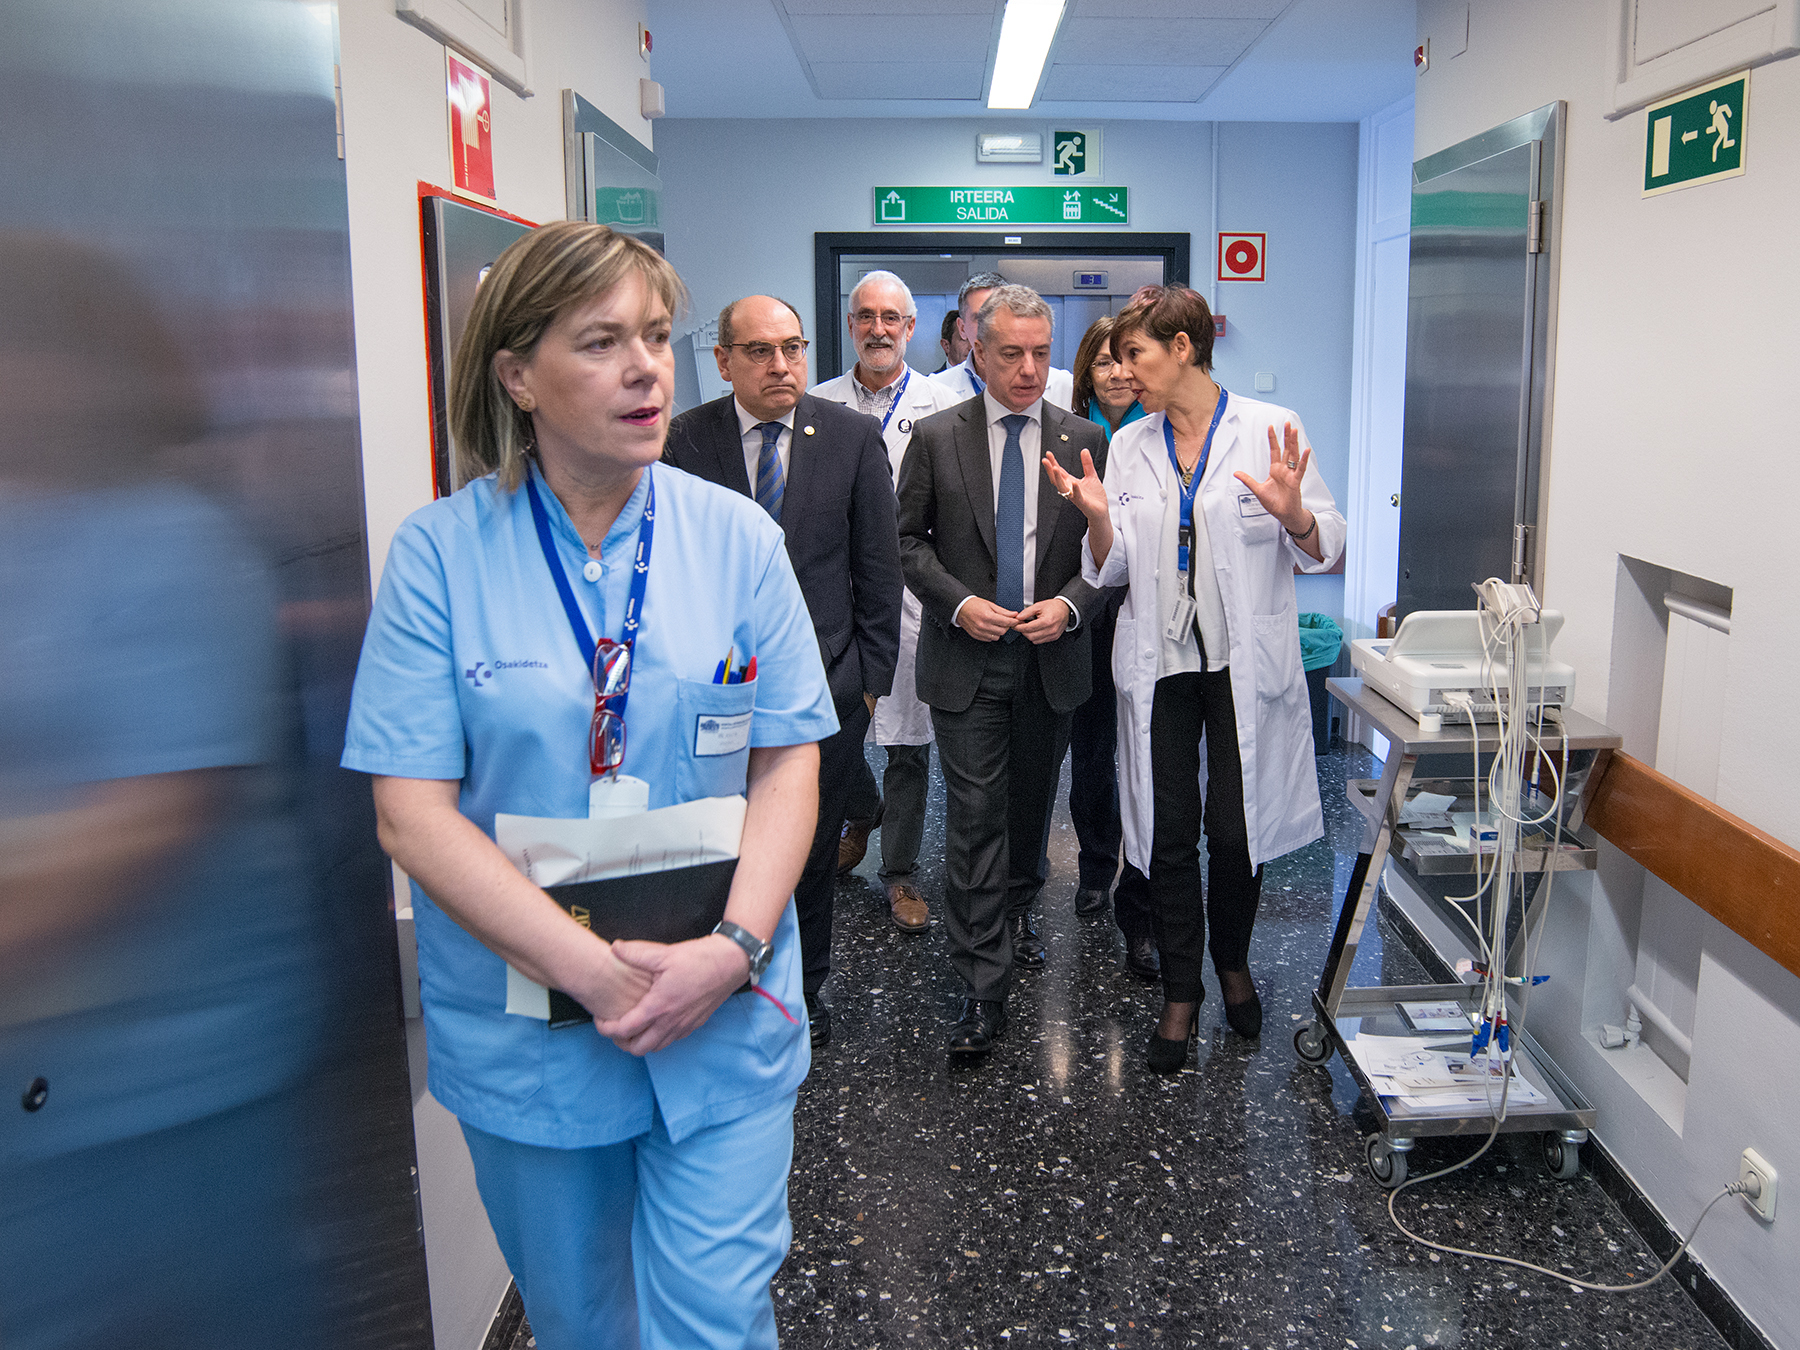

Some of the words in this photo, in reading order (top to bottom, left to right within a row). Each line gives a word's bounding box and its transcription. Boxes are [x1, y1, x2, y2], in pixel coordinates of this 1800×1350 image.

[950, 190, 1015, 204] IRTEERA
[956, 206, 1009, 221] SALIDA
[1089, 275, 1095, 285] 3
[494, 660, 549, 669] Osakidetza
